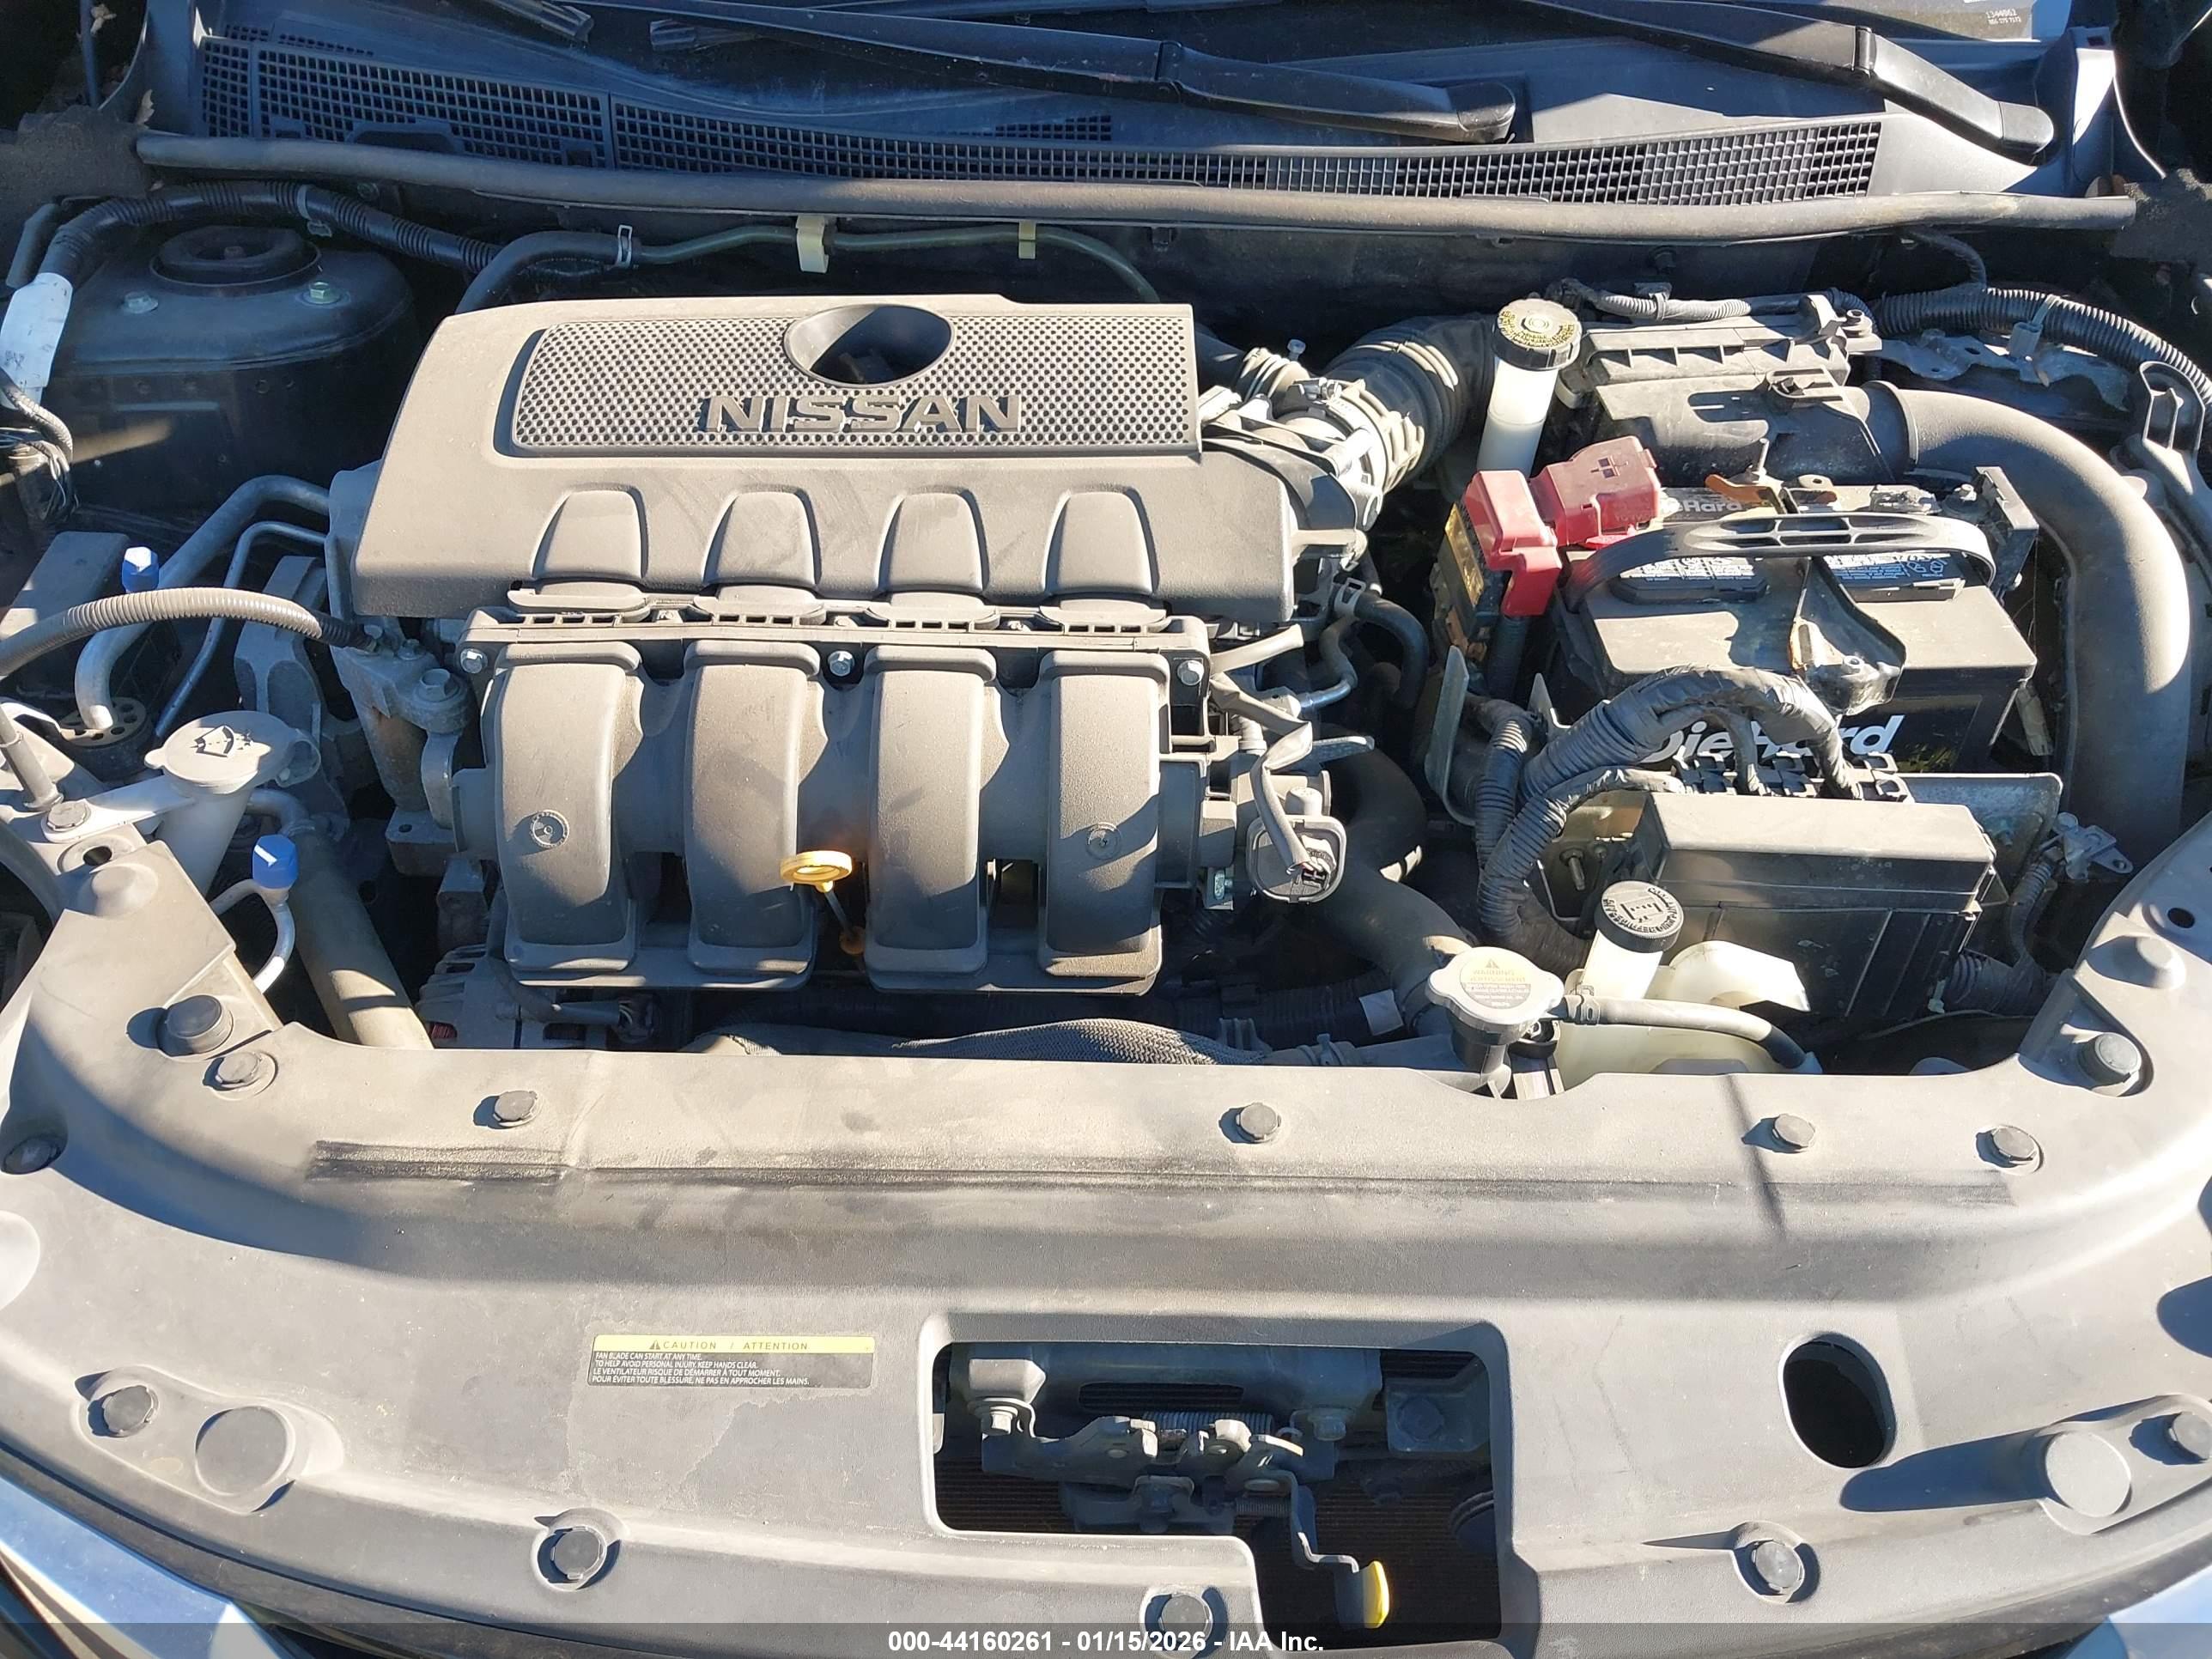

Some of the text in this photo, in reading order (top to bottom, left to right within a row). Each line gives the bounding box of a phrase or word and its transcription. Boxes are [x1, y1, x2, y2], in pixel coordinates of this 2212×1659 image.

[704, 395, 1022, 433] NISSAN
[743, 1342, 808, 1351] ATTENTION
[684, 1368, 721, 1376] DÉMARRER
[612, 1375, 635, 1383] ÉVITER
